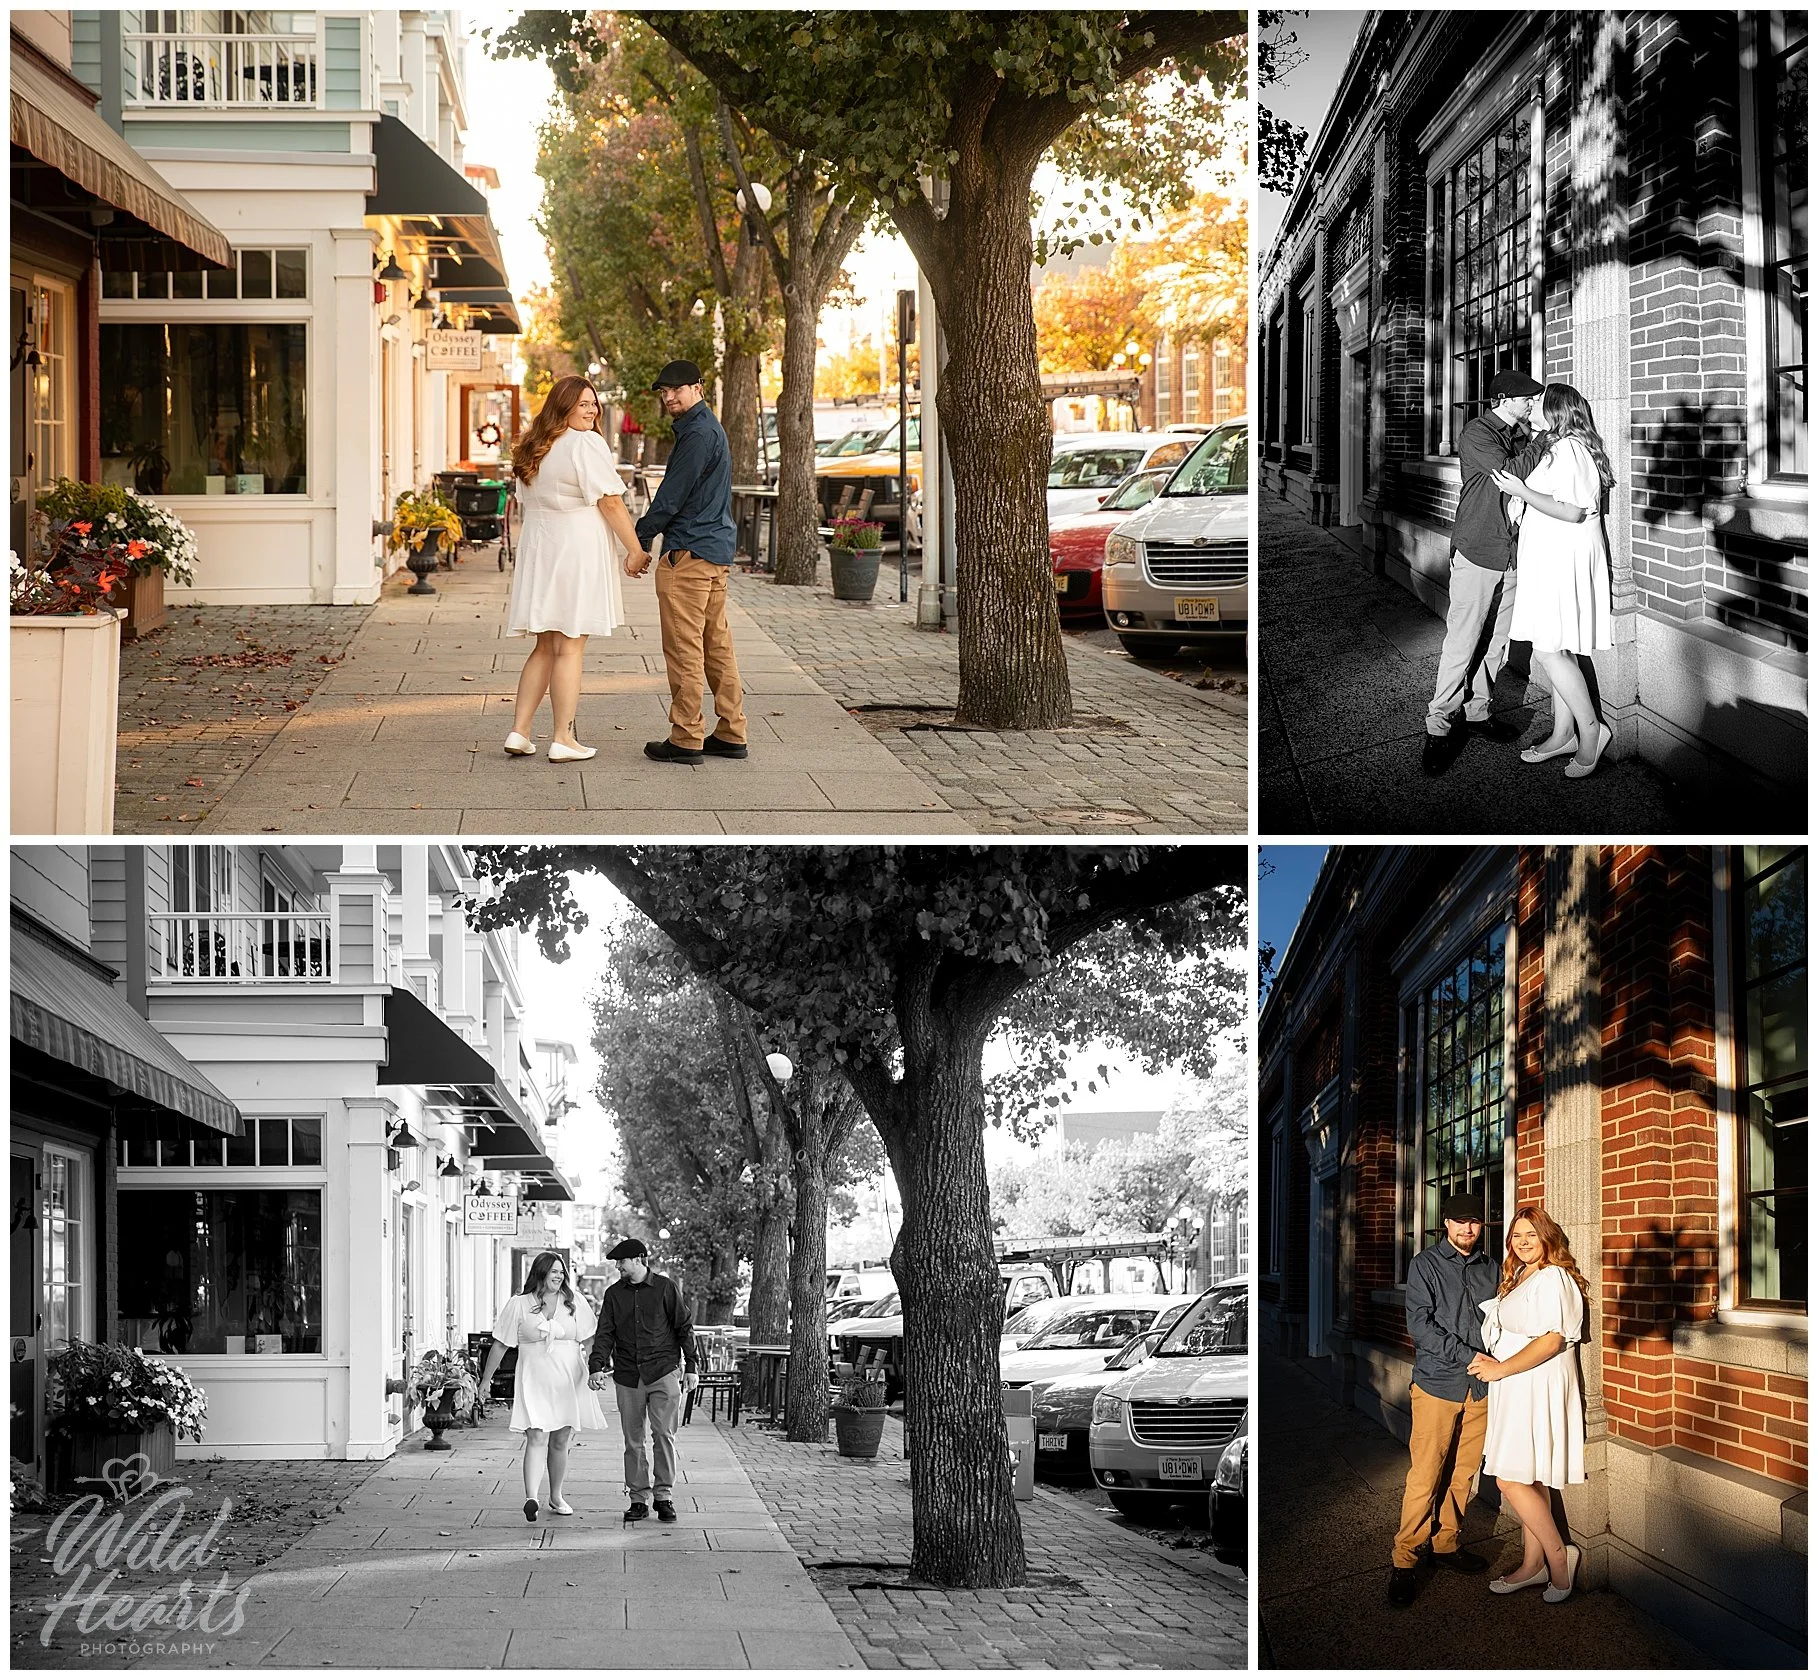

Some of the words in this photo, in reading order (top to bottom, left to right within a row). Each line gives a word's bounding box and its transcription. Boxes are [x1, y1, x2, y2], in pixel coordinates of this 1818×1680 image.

[433, 332, 475, 345] Odyssey
[470, 1199, 512, 1211] Odyssey
[1041, 1437, 1065, 1447] THRIVE
